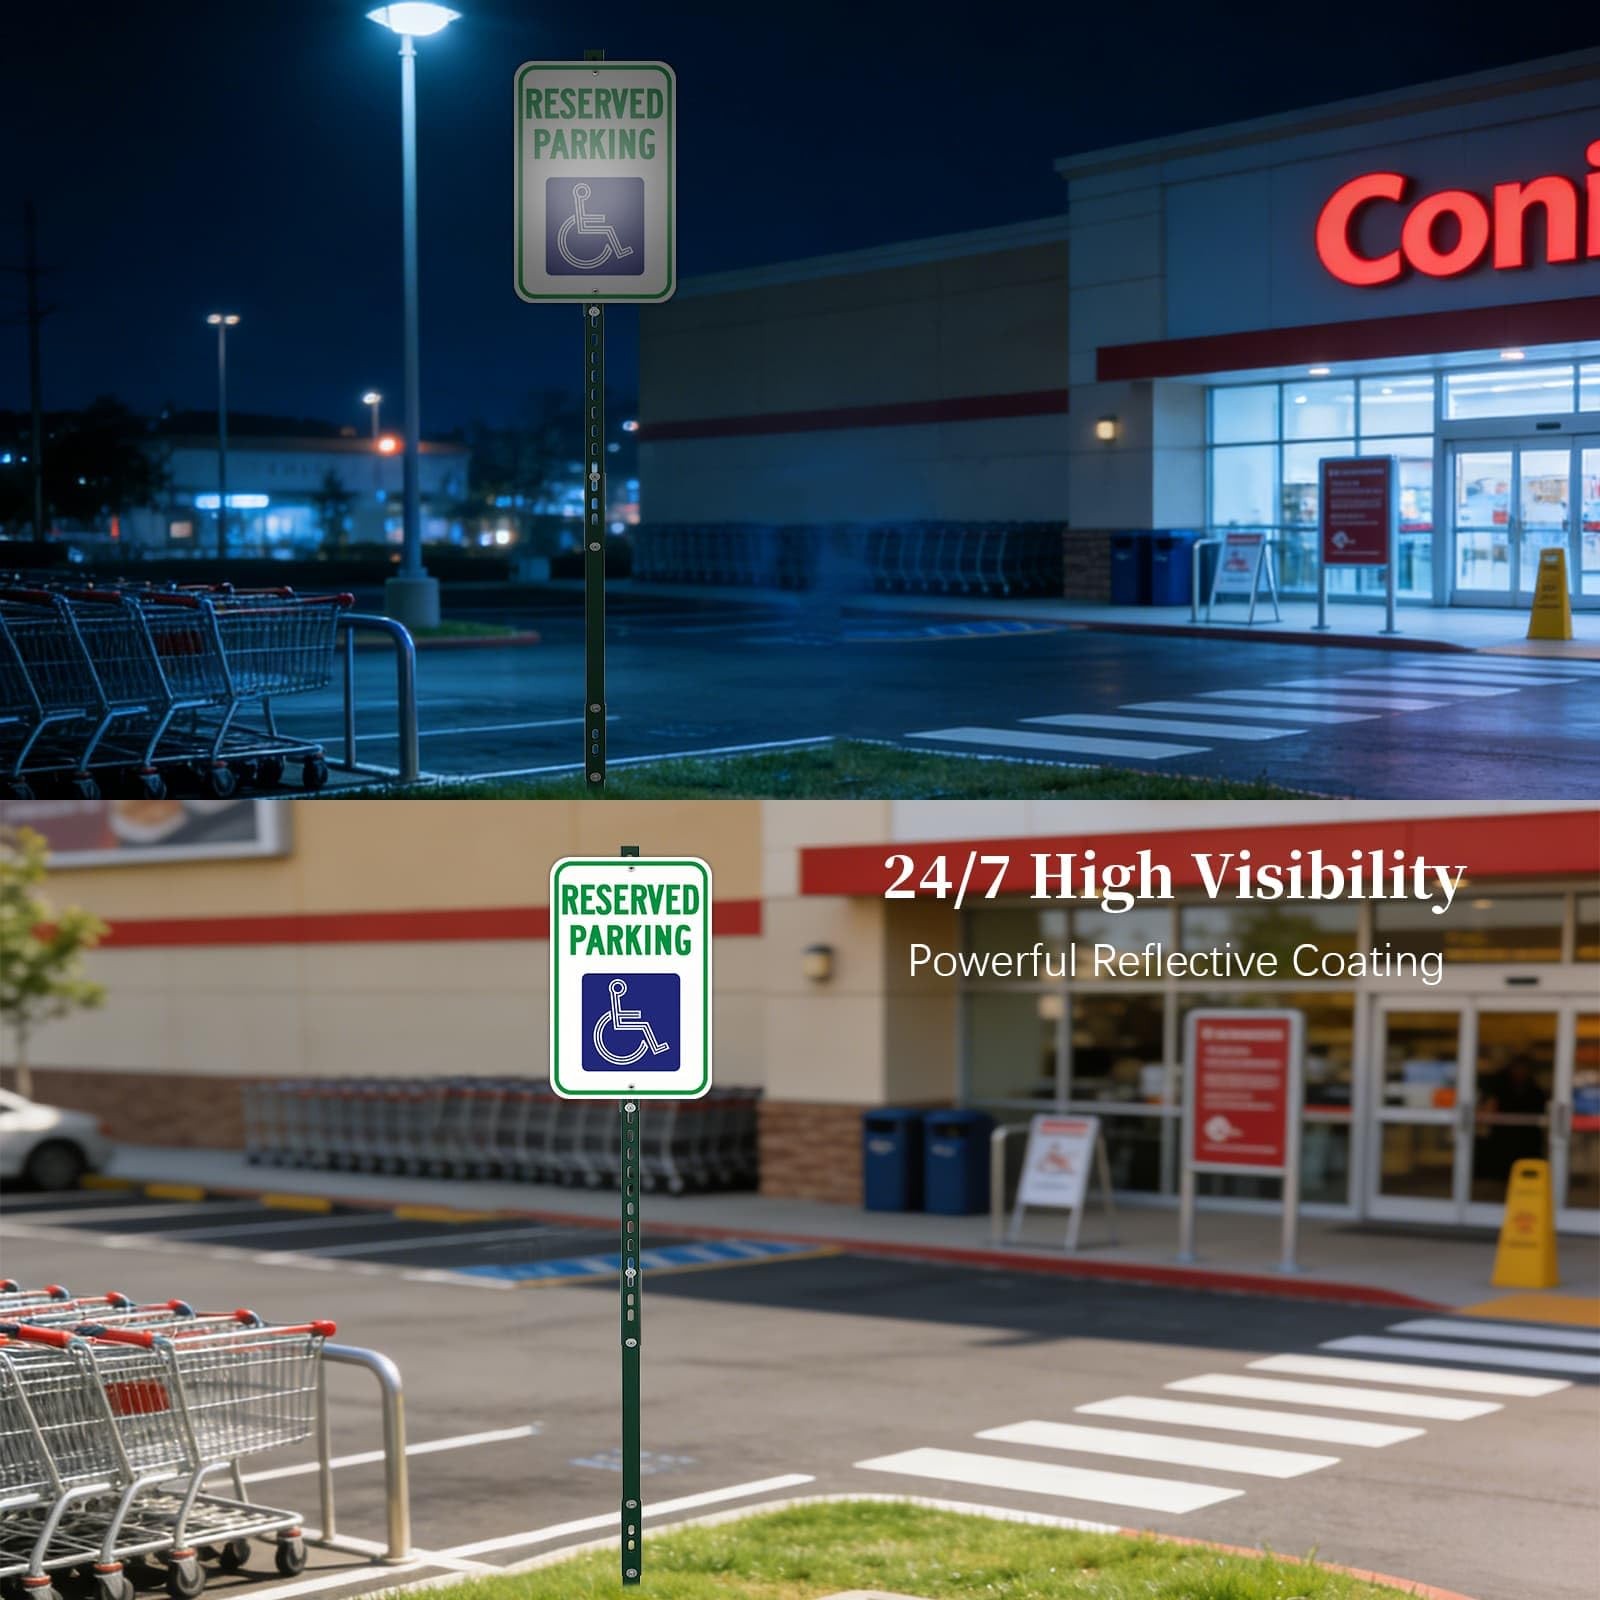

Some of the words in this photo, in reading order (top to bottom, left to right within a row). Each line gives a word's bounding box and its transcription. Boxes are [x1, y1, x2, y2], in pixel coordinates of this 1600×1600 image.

[525, 87, 664, 120] RESERVED
[533, 128, 656, 160] PARKING
[561, 884, 700, 915] RESERVED
[570, 924, 692, 956] PARKING
